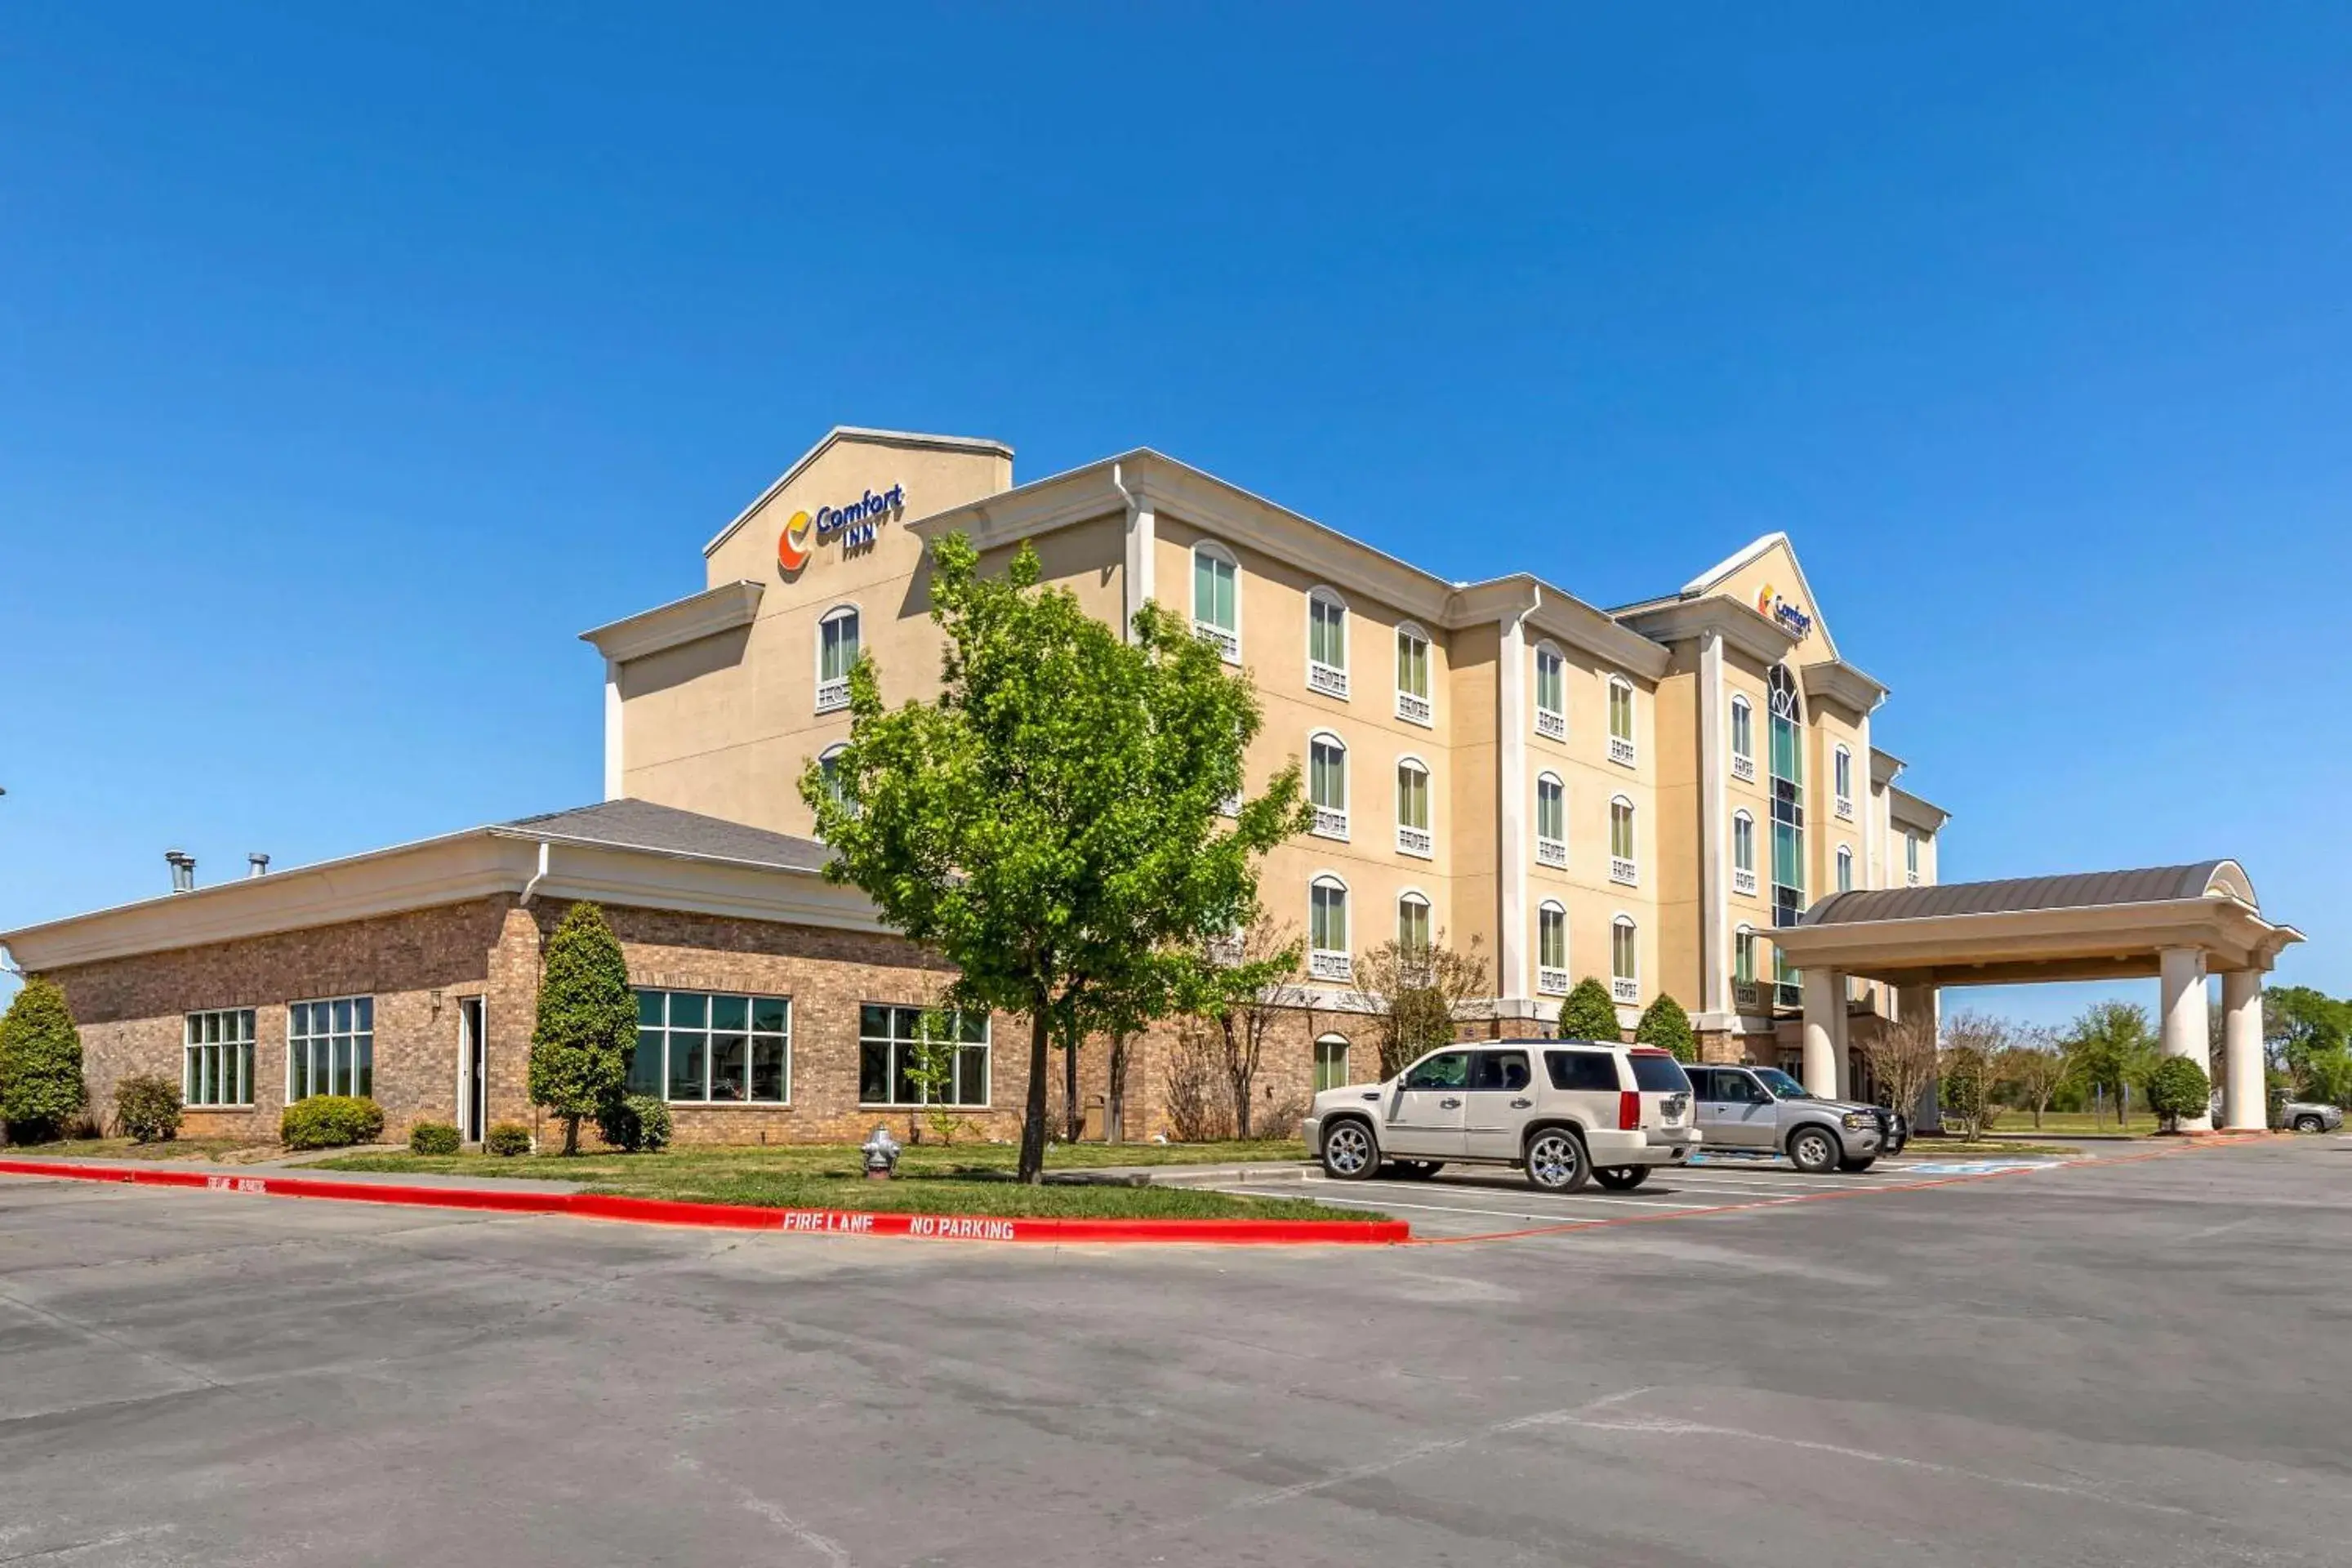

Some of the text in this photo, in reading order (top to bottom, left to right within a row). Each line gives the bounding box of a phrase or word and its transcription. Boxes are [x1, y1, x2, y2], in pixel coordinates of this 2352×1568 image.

[817, 483, 903, 532] Comfort
[844, 523, 875, 547] INN
[1775, 595, 1811, 633] Comfort
[783, 1212, 875, 1232] FIRE LANE
[909, 1216, 1013, 1240] NO PARKING
